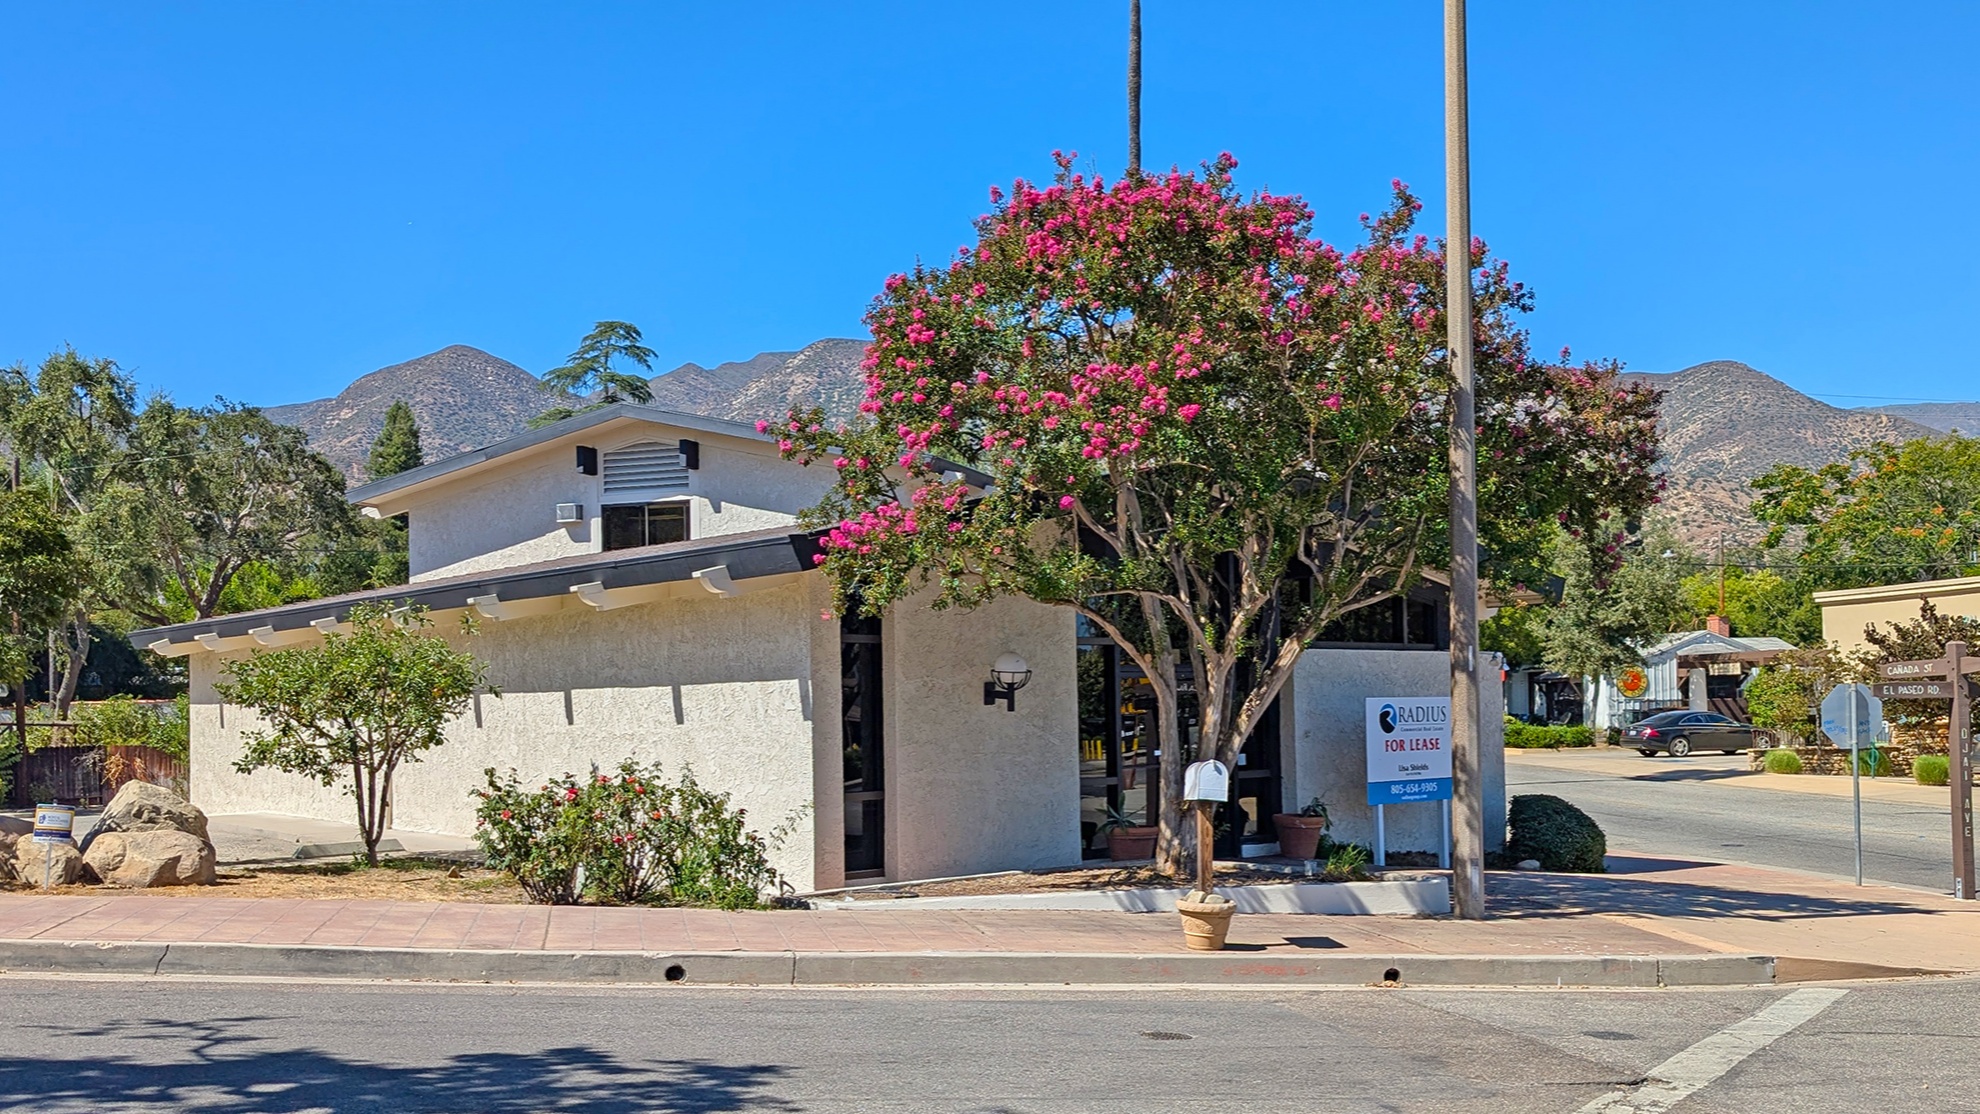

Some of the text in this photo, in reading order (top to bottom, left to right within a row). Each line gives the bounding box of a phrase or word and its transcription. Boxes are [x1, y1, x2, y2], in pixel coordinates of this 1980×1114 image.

[1887, 663, 1936, 676] CAÑADA ST.
[1883, 685, 1941, 695] EL PASEO RD.
[1398, 705, 1447, 723] RADIUS
[1385, 738, 1441, 752] FOR LEASE
[1398, 763, 1429, 772] Lisa Shields
[1391, 782, 1438, 794] 805-654-9305
[1961, 727, 1971, 837] OJAI AVE
